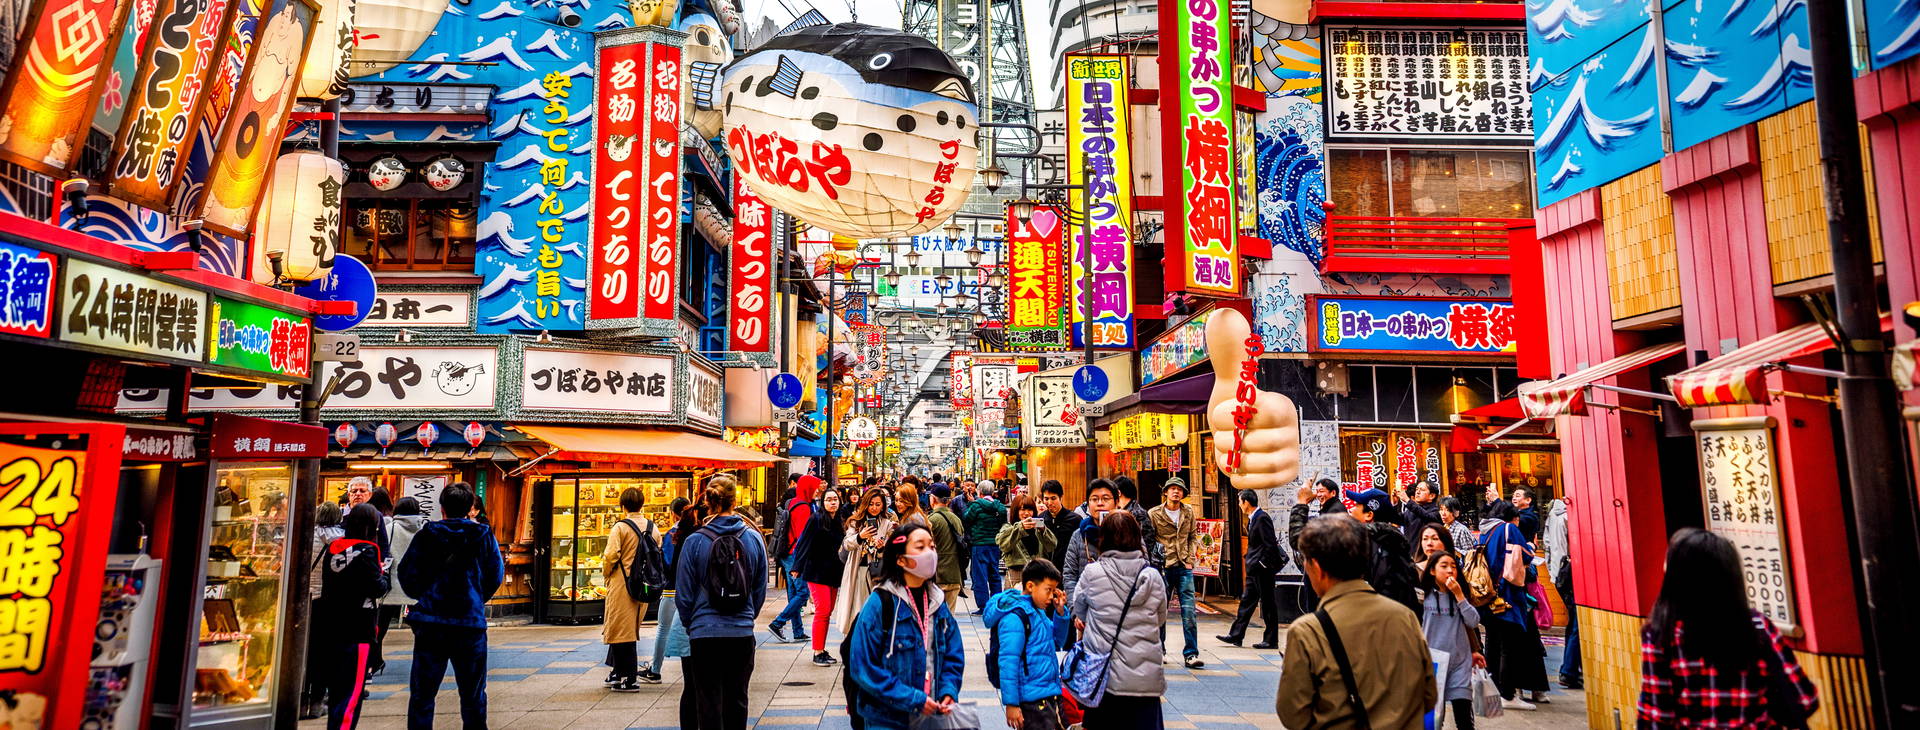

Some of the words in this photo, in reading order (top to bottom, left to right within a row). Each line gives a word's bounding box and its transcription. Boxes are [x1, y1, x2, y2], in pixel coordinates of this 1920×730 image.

[1187, 0, 1220, 112] の串かつ
[608, 59, 637, 123] 名物
[654, 59, 677, 124] 名物
[1334, 79, 1350, 131] もち
[1352, 80, 1369, 131] うずら玉子
[1369, 80, 1387, 131] 紅しょうが
[1386, 80, 1402, 131] にんにく
[1404, 81, 1420, 131] 玉ねぎ
[1421, 80, 1439, 131] 山芋
[1439, 81, 1456, 132] しし唐
[1456, 81, 1474, 132] れんこん
[1473, 81, 1491, 132] 銀杏
[1491, 81, 1508, 132] 白ねぎ
[1508, 81, 1526, 133] さつま芋
[728, 124, 851, 200] づぼらや
[915, 139, 961, 223] づぼらや
[1082, 82, 1117, 221] 日本一の串かつ
[535, 71, 573, 319] 安うて何んでも旨い
[1184, 115, 1233, 254] 横綱
[601, 170, 632, 304] てっちり
[649, 171, 676, 304] てっちり
[1013, 242, 1045, 327] 通天閣
[1047, 242, 1058, 326] TSUTENKAKU
[1075, 225, 1127, 319] 横綱
[1194, 255, 1232, 288] 酒処
[68, 273, 198, 354] 24時間営業
[368, 297, 453, 320] 日本一
[1029, 329, 1059, 344] 横綱
[1324, 304, 1340, 344] 新世界
[1341, 312, 1447, 340] 日本一の串かつ
[219, 319, 270, 355] 日本一の串かつ
[270, 317, 312, 376] 横綱
[530, 367, 666, 398] づぼらや本店
[234, 437, 271, 453] 横綱
[1373, 442, 1387, 486] ソースの
[1715, 437, 1733, 522] 天丼
[1728, 435, 1747, 523] ふぐ天ぷら
[1742, 435, 1760, 524] ふぐ天丼
[1756, 435, 1775, 525] ふぐカツ丼
[0, 457, 80, 673] 24時間
